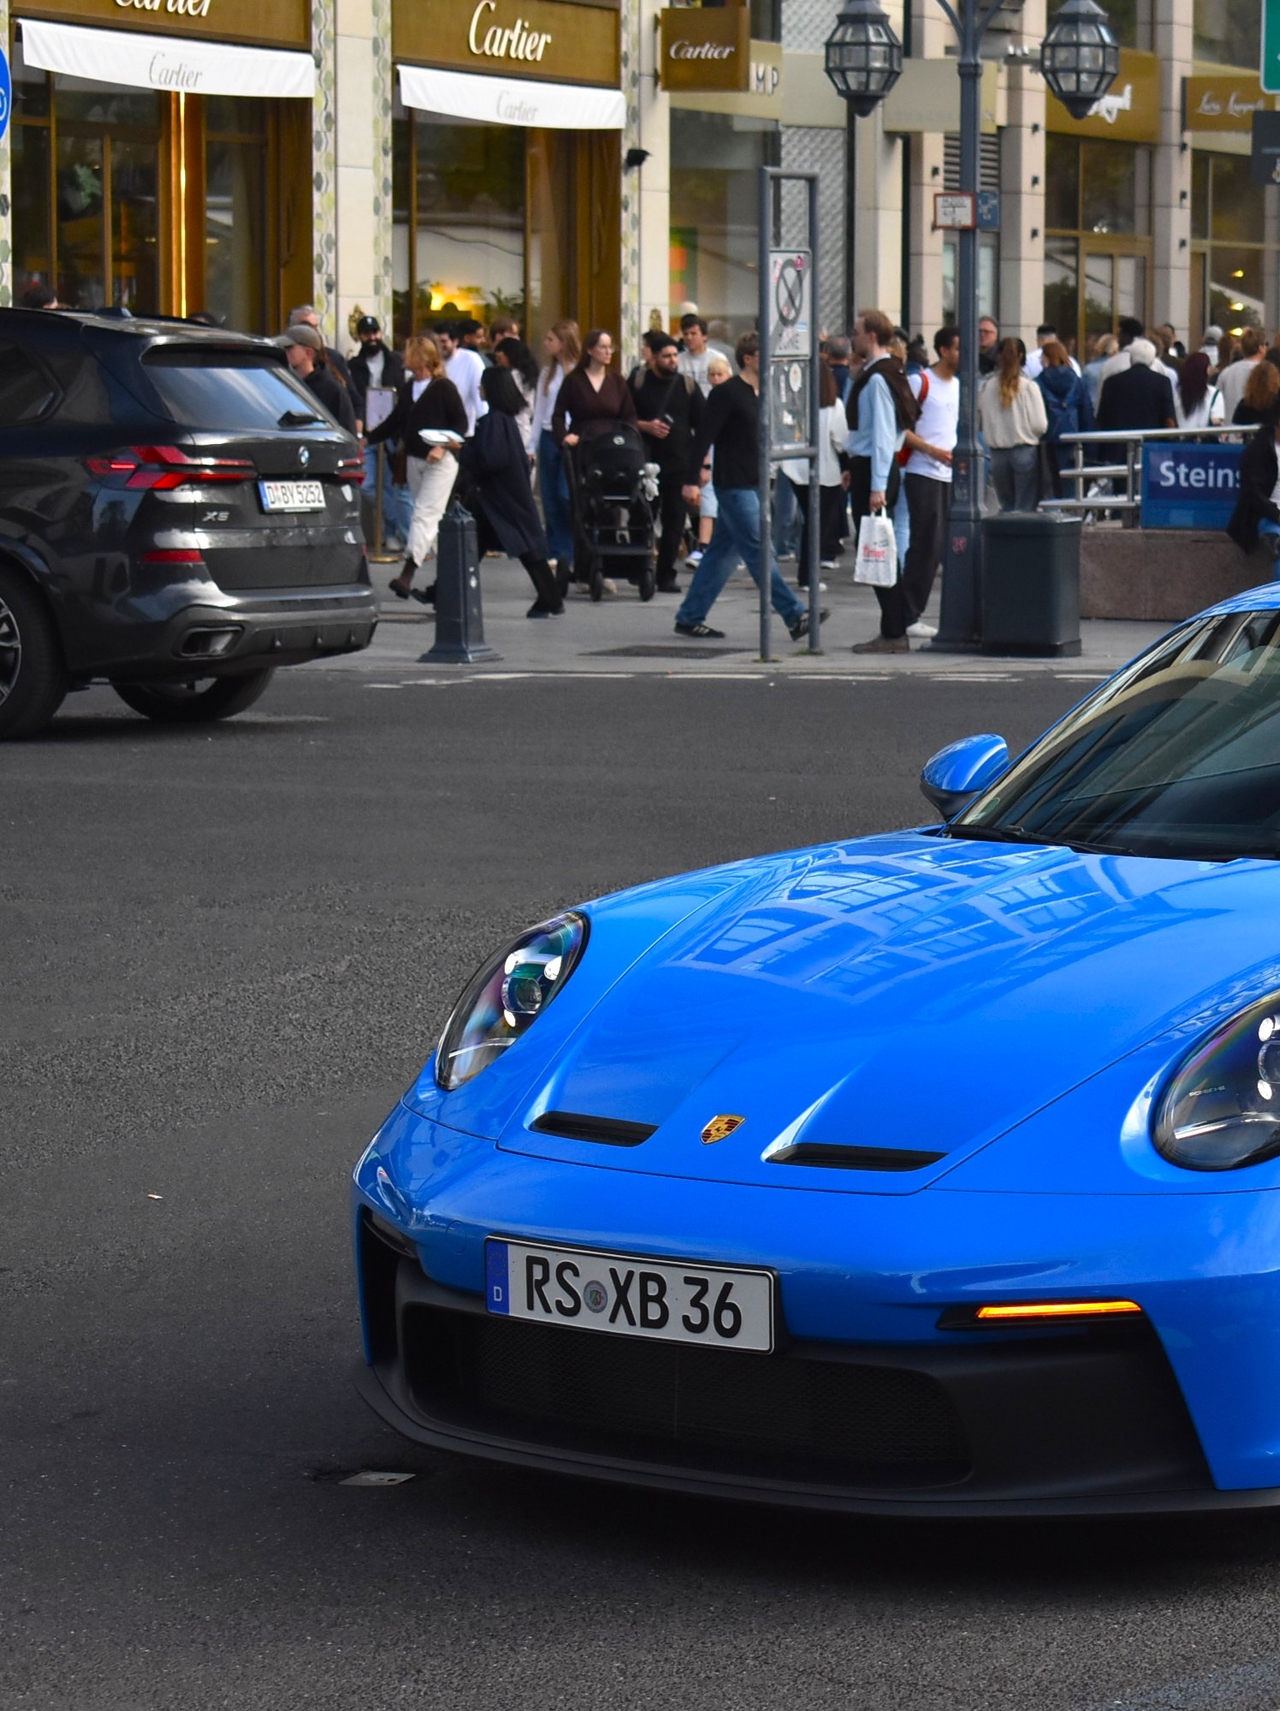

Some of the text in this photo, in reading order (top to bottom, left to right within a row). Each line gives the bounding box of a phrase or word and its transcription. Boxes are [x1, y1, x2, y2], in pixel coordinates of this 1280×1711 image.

[469, 0, 552, 61] Cartier
[669, 40, 735, 59] Cartier
[149, 52, 203, 88] Cartier
[496, 90, 539, 122] Cartier
[493, 1254, 743, 1339] D RS XB 36
